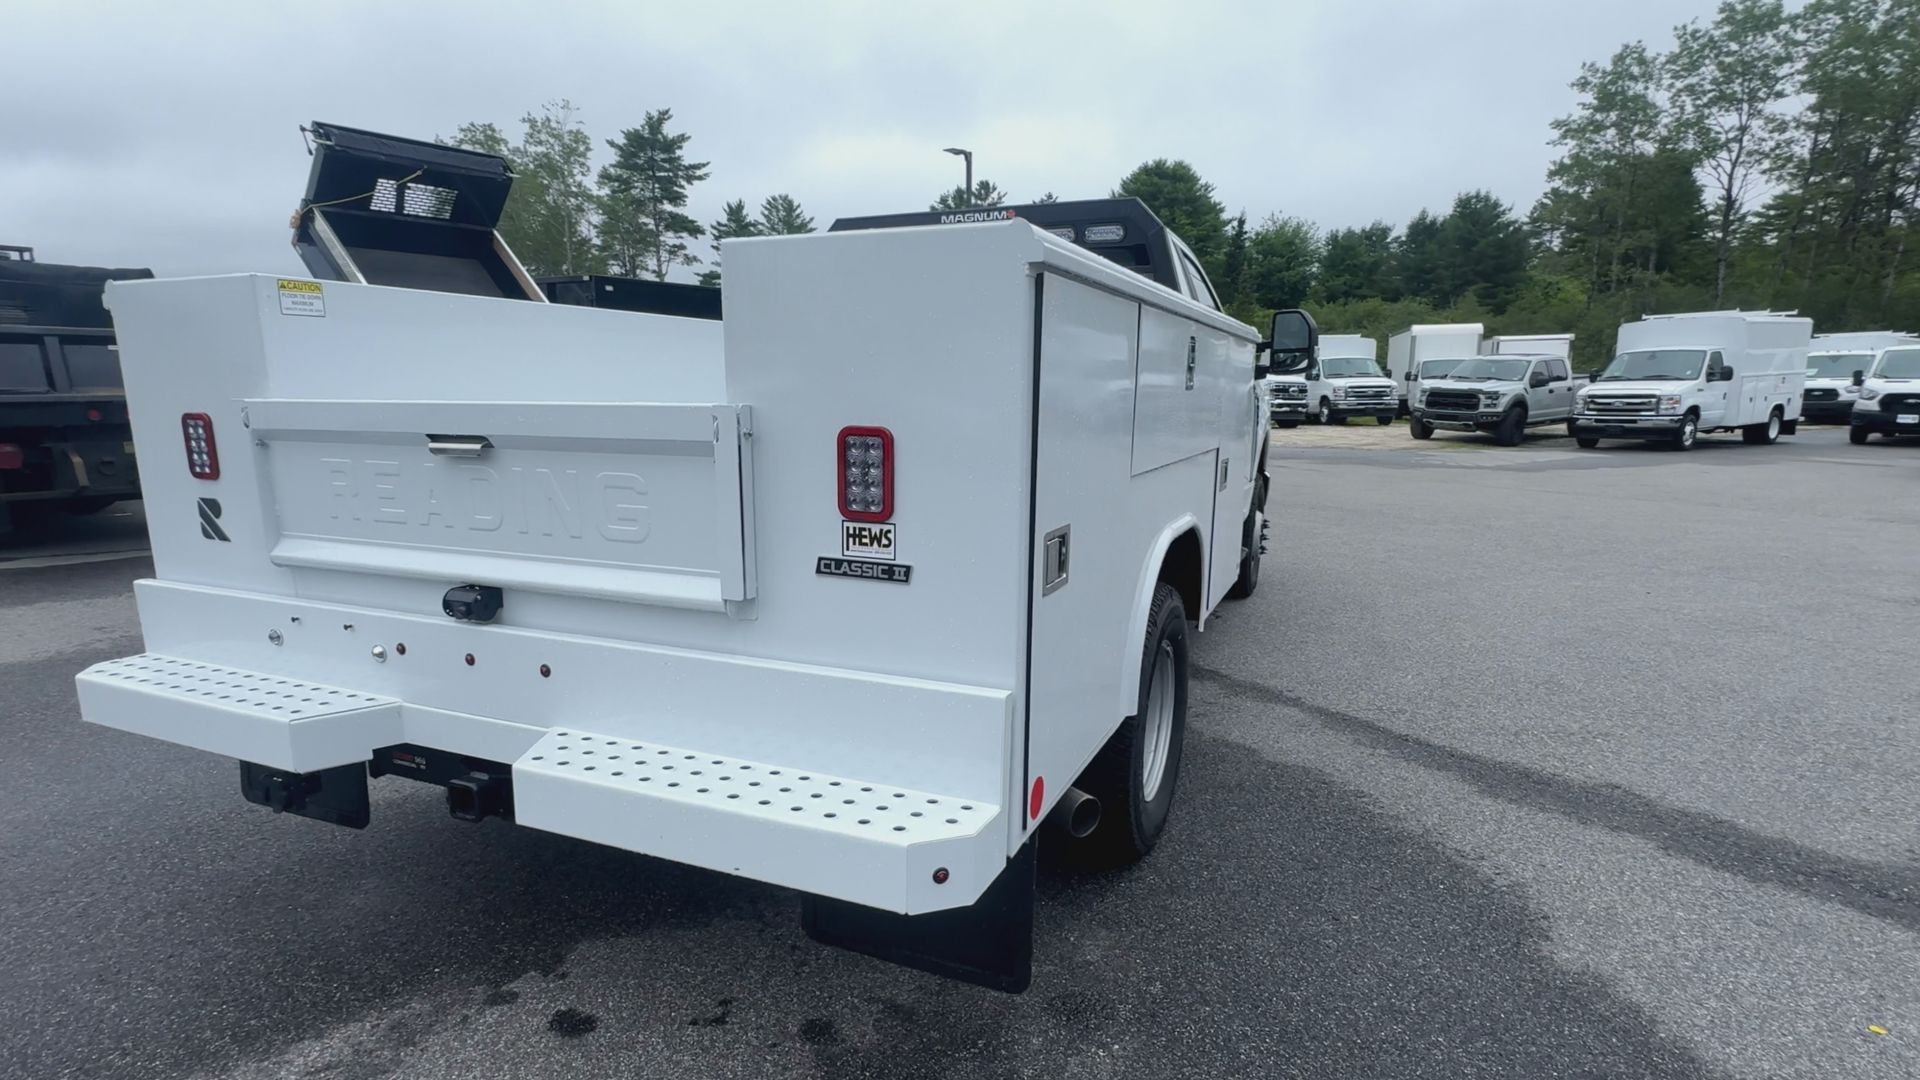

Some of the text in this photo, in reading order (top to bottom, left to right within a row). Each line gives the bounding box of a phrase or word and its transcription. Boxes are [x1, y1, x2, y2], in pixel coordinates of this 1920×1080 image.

[941, 210, 1007, 224] MAGNUM
[286, 281, 321, 292] CAUTION
[320, 458, 650, 544] READING
[846, 526, 892, 551] HEWS
[820, 560, 907, 580] CLASSIC II
